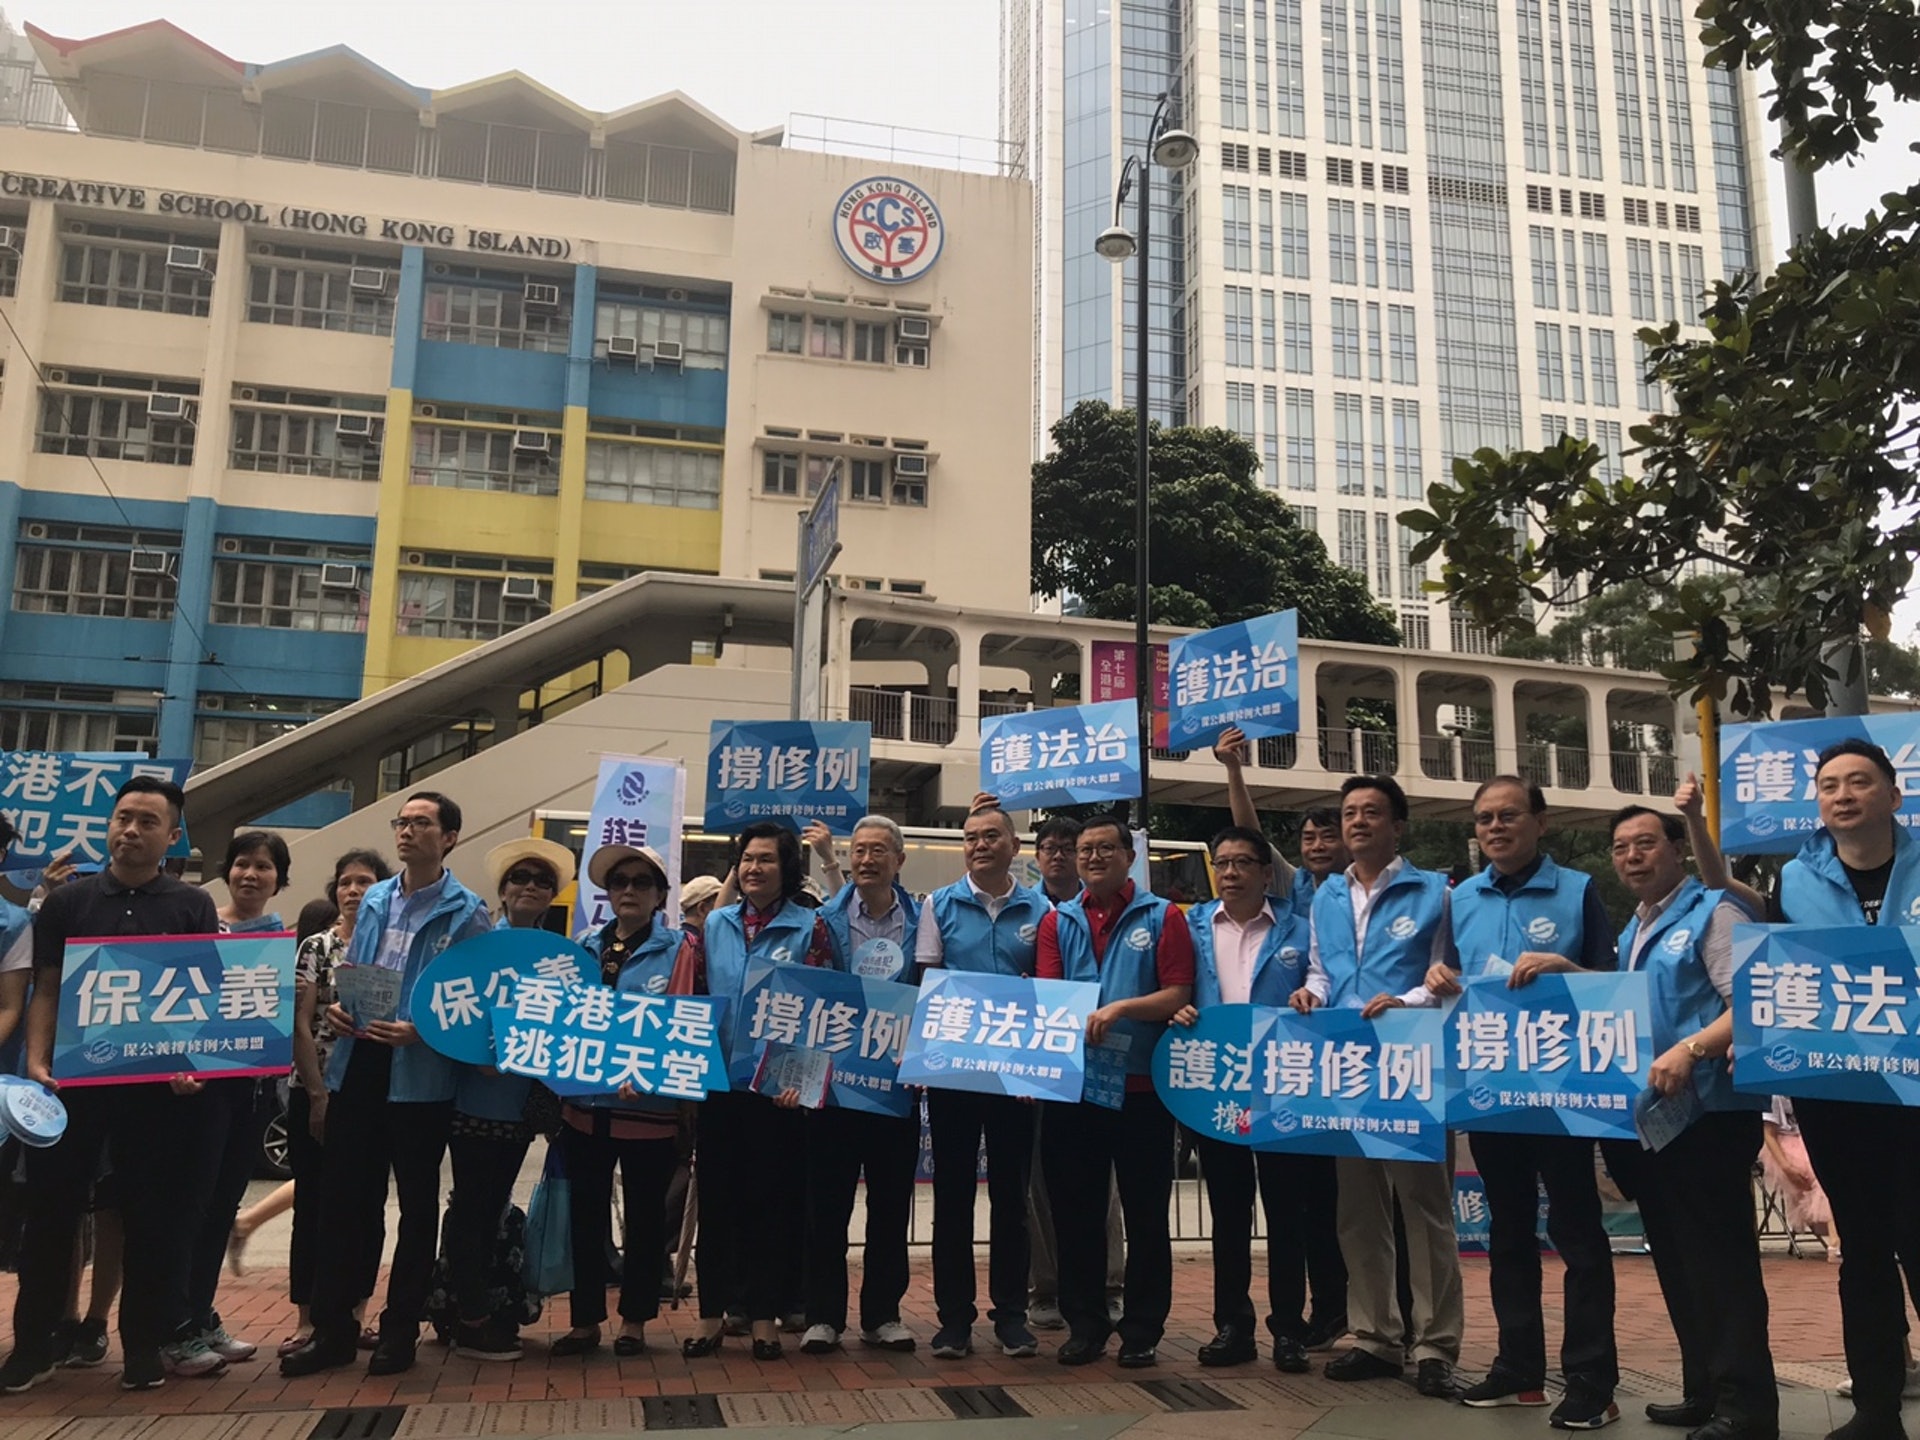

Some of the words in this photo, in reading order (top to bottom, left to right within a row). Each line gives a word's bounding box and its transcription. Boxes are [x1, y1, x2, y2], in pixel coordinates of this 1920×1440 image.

[1, 174, 145, 209] CREATIVE
[158, 193, 269, 224] SCHOOL
[279, 206, 368, 236] (HONG
[380, 218, 455, 246] KONG
[467, 228, 572, 260] ISLAND)
[840, 190, 865, 219] HONG
[866, 183, 901, 194] KONG
[905, 189, 938, 229] ISLAND
[862, 197, 915, 232] CCS
[1176, 640, 1288, 707] 護法治
[717, 746, 861, 792] 撐修例
[990, 722, 1128, 775] 護法治
[0, 752, 175, 807] 港不
[75, 962, 281, 1028] 保公義
[514, 976, 716, 1048] 香港不是
[921, 994, 1081, 1053] 護法治
[1749, 961, 1920, 1036] 護法
[123, 1036, 264, 1058] 保公義撐修例大聯盟
[749, 988, 912, 1063] 撐修例
[1456, 1009, 1638, 1074] 撐修例
[499, 1025, 709, 1099] 逃犯天堂
[1263, 1040, 1433, 1102] 撐修例
[1301, 1114, 1421, 1135] 保公義撐修例大聯盟
[1500, 1090, 1628, 1111] 保公義撐修例大聯盟
